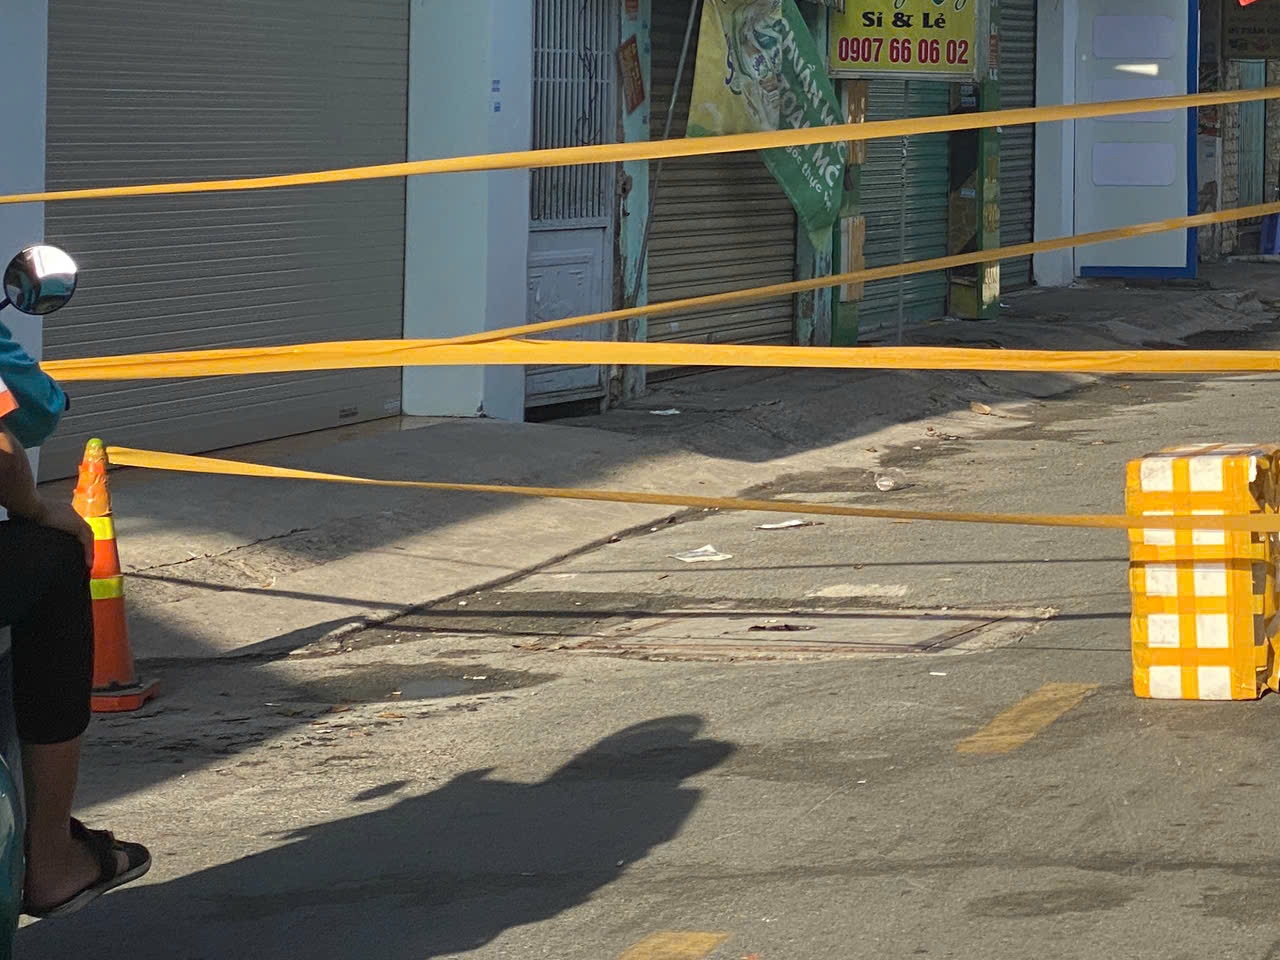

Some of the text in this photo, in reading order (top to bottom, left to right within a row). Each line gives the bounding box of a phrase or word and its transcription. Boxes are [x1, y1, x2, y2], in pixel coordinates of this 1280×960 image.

[862, 11, 946, 28] Sỉ & Lẻ
[839, 37, 969, 64] 0907 66 06 02
